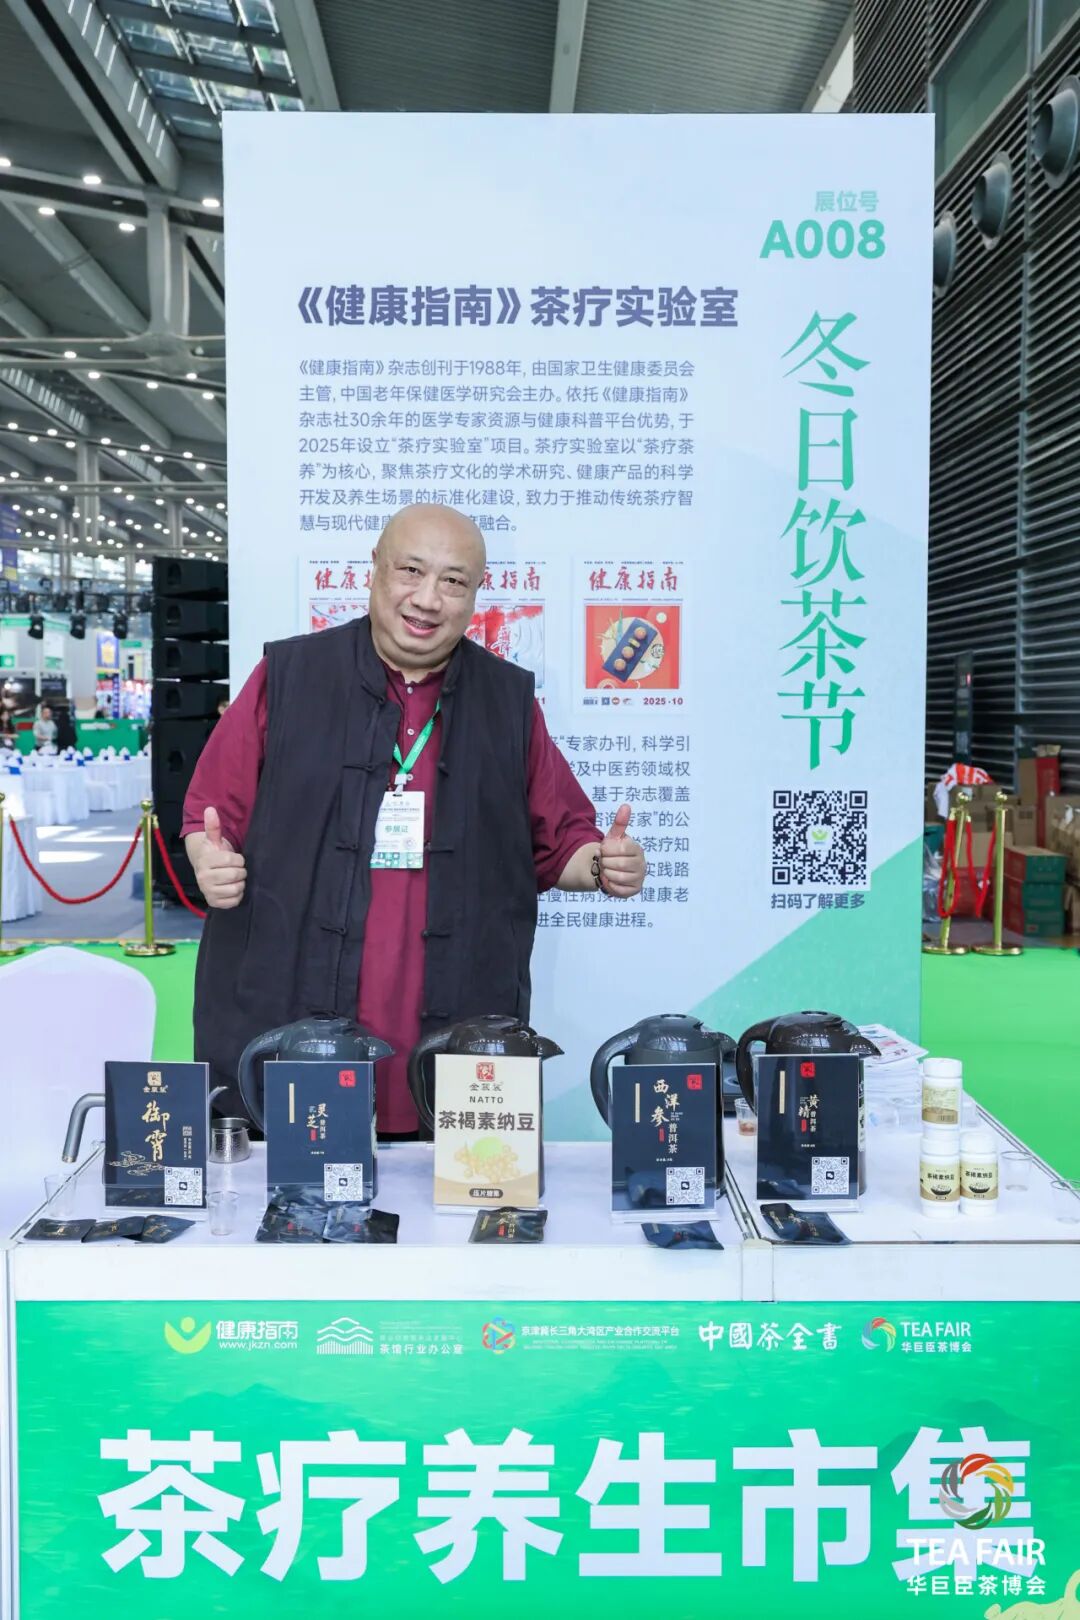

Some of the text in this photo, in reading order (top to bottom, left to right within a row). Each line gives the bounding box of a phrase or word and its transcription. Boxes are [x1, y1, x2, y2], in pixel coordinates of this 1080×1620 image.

[815, 190, 880, 213] 展位号
[760, 219, 886, 260] A008
[297, 284, 739, 328] 《健康指南》茶疗实验室
[776, 310, 871, 771] 冬日饮茶节
[589, 566, 678, 592] 健康指南
[592, 785, 690, 802] 基于杂志覆盖
[632, 836, 690, 853] 茶疗知
[771, 892, 866, 909] 扫码了解更多
[469, 1096, 504, 1104] NATTO
[438, 1110, 535, 1131] 茶褐素纳豆
[668, 1122, 678, 1154] 普洱茶
[216, 1320, 298, 1340] 健康指南
[901, 1321, 972, 1337] TEA FAIR
[219, 1341, 298, 1352] www.jkzn.com
[380, 1344, 464, 1356] 茶馆行业办公室
[901, 1341, 972, 1353] 华巨臣茶博会
[97, 1426, 1035, 1586] 茶疗养生市集
